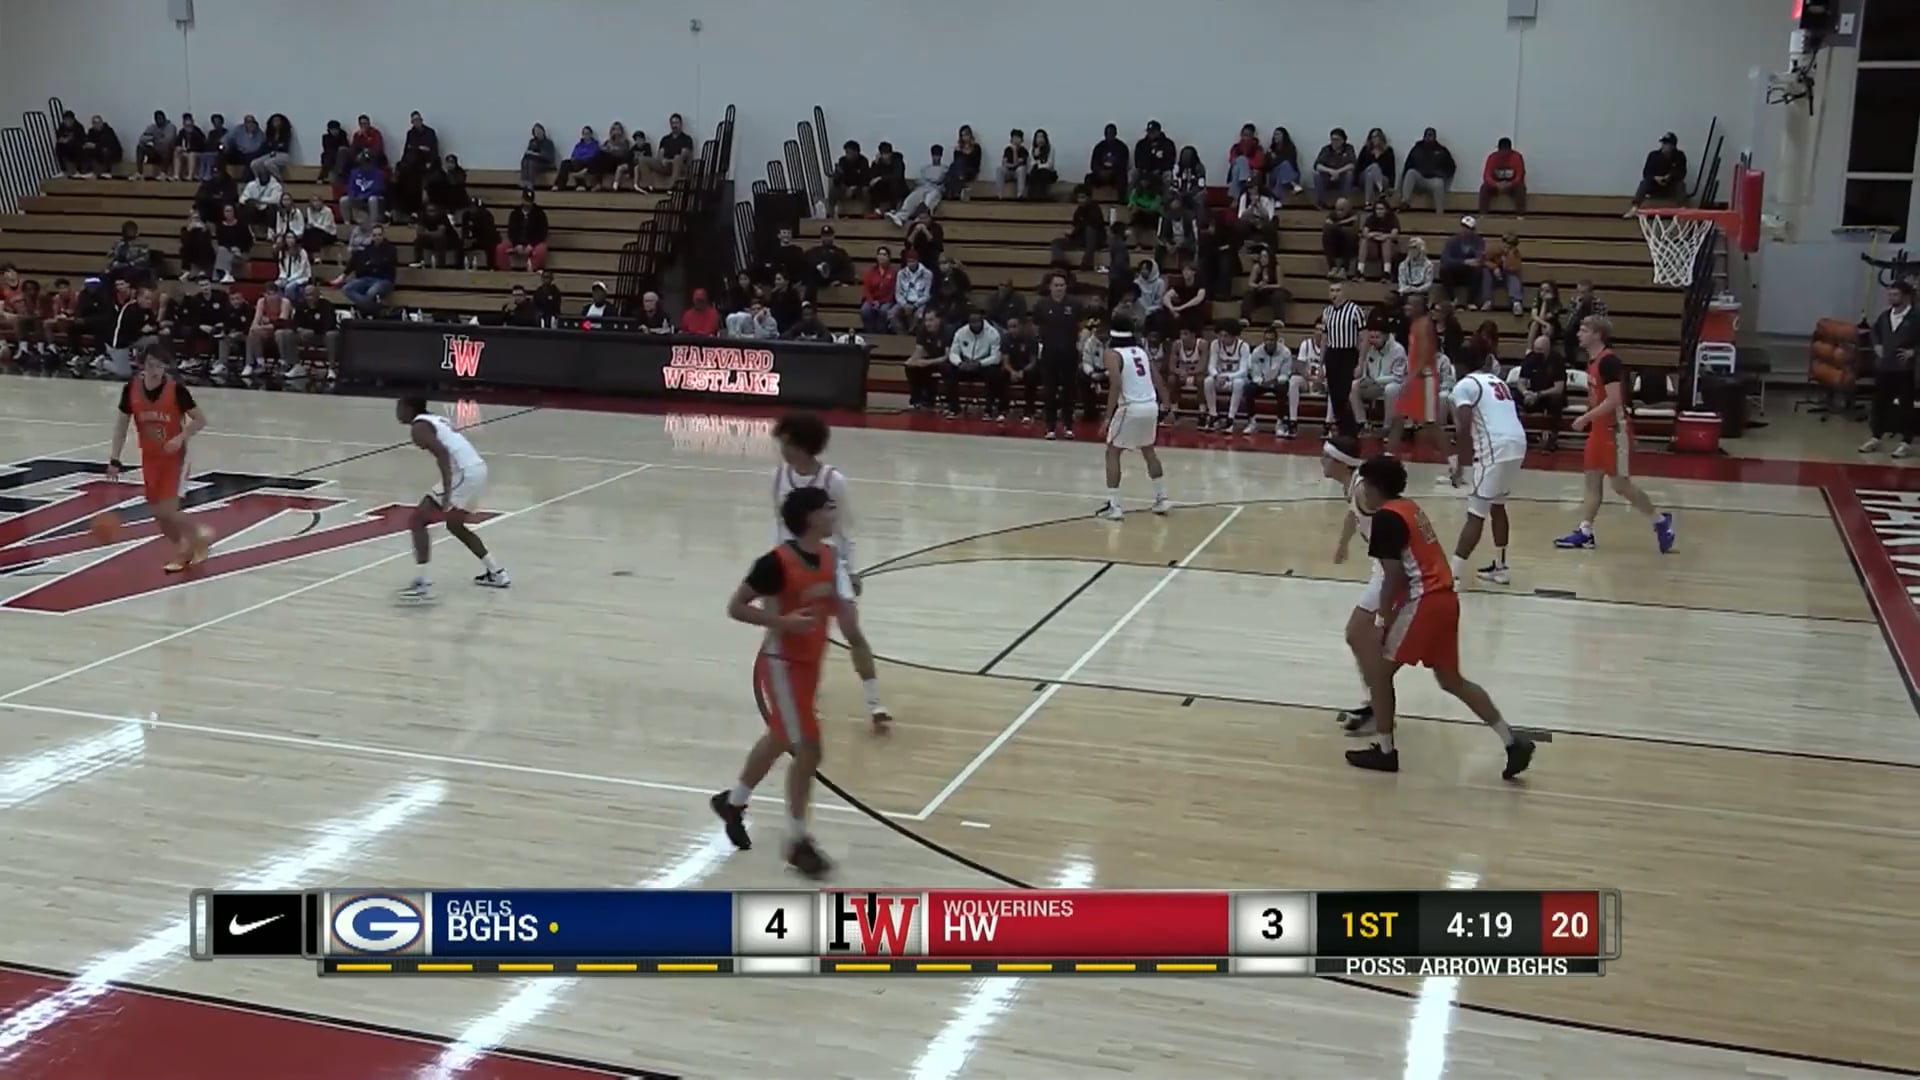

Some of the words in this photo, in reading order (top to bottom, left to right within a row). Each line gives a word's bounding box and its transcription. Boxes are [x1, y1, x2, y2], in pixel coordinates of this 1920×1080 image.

[671, 346, 774, 372] HARVARD
[1133, 357, 1146, 377] 5
[663, 366, 780, 395] WESTLAKE
